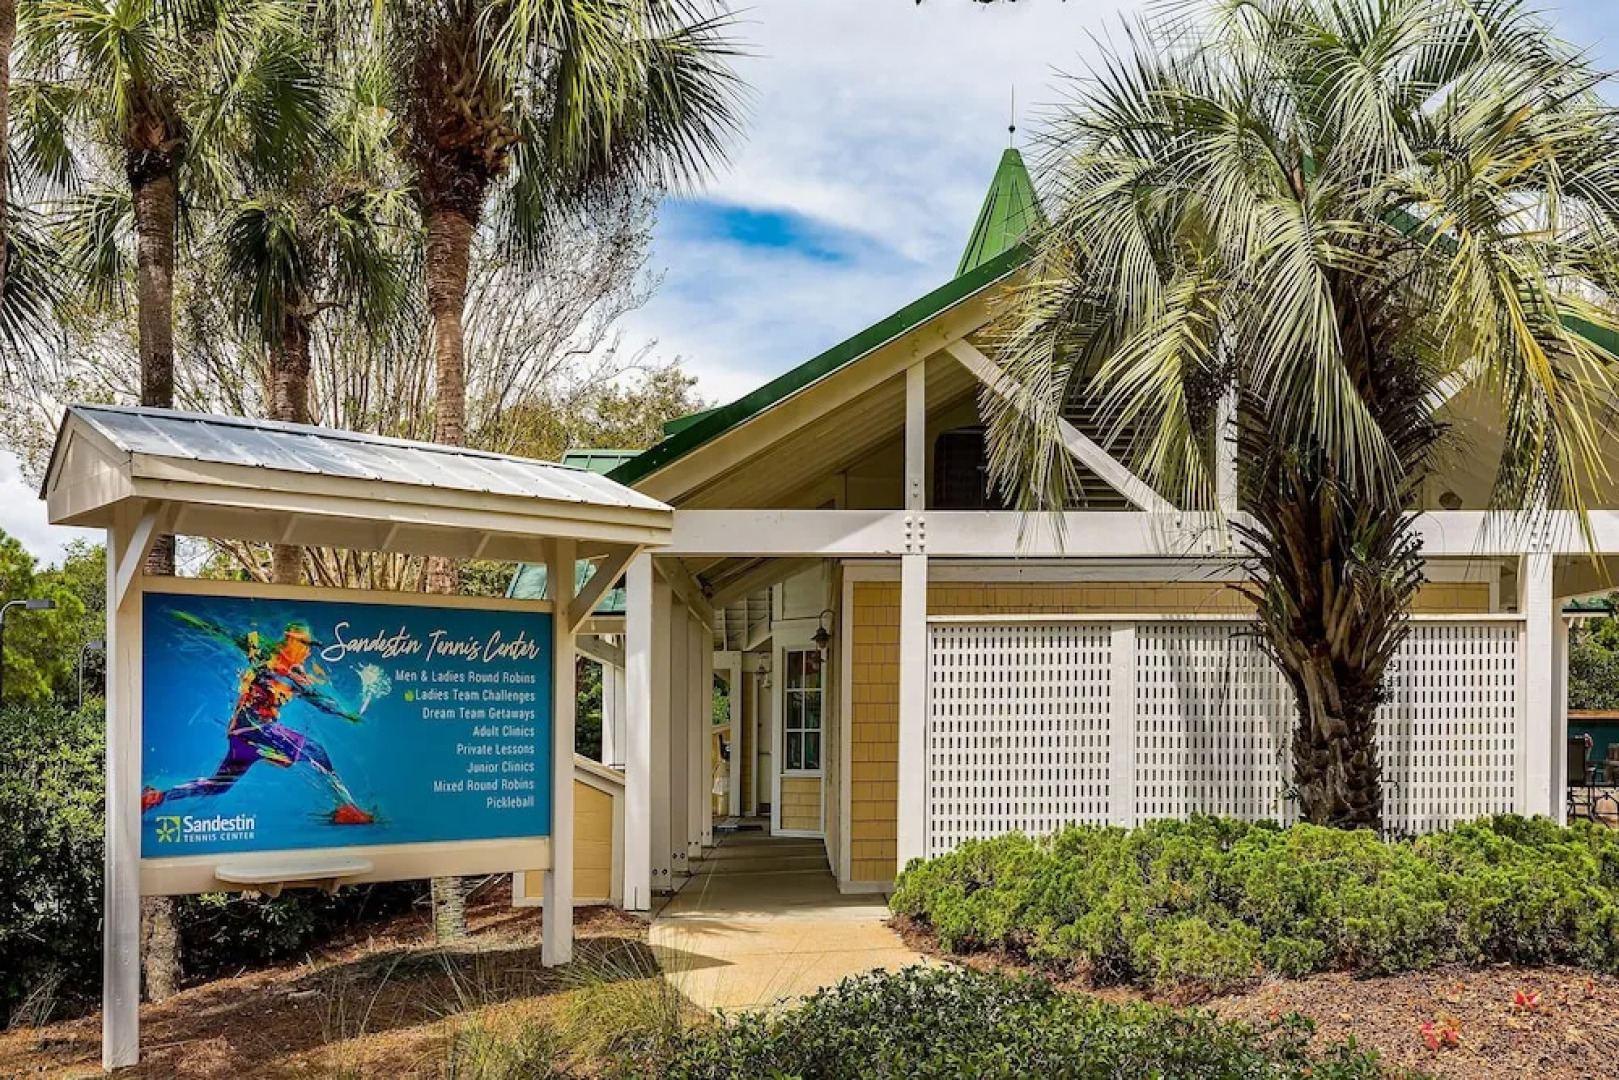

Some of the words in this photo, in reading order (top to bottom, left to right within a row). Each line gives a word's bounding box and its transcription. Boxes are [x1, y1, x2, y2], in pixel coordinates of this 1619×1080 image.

[320, 621, 422, 662] Sandestin
[425, 629, 482, 661] Tennis
[483, 630, 540, 663] Center
[395, 669, 417, 681] Men
[421, 670, 428, 681] &
[432, 670, 465, 683] Ladies
[469, 672, 499, 683] Round
[503, 672, 536, 684] Robins
[415, 689, 448, 700] Ladies
[453, 690, 479, 701] Team
[482, 689, 535, 704] Challenges
[422, 707, 455, 719] Dream
[460, 708, 484, 719] Team
[489, 708, 535, 722] Getaways
[473, 725, 499, 737] Adult
[502, 725, 535, 737] Clinics
[457, 743, 492, 755] Private
[495, 743, 535, 754] Lessons
[467, 762, 498, 773] Junior
[502, 761, 535, 772] Clinics
[434, 780, 464, 792] Mixed
[467, 781, 497, 791] Round
[501, 779, 534, 790] Robins
[486, 797, 534, 808] Pickleball
[182, 813, 255, 833] Sandestin
[184, 833, 217, 843] TENNIS
[220, 831, 255, 841] CENTER
